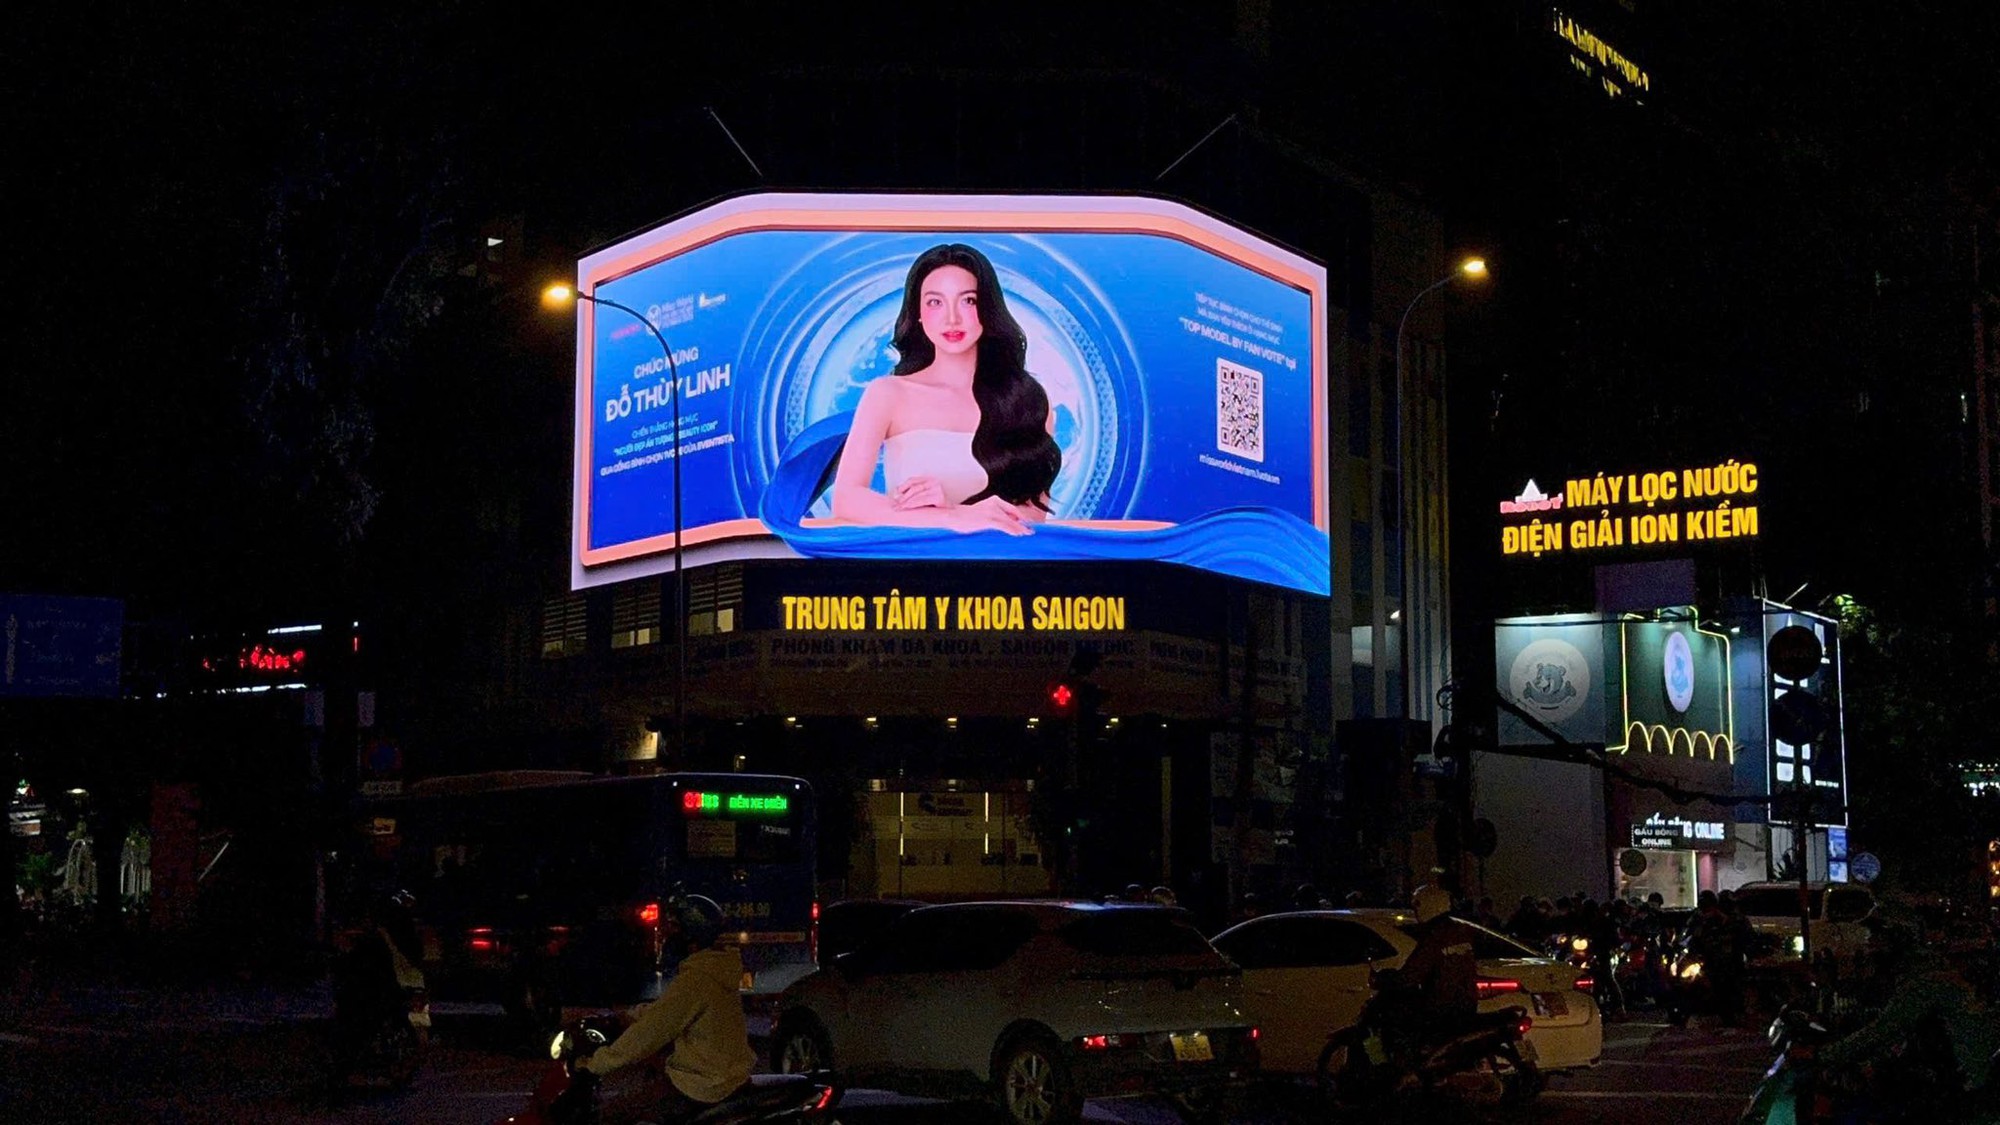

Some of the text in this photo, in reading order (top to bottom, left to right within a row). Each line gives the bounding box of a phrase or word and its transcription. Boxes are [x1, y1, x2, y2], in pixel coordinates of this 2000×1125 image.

[1200, 324, 1231, 346] MODEL
[634, 356, 664, 379] CHÚC
[606, 383, 632, 422] ĐỖ
[685, 363, 731, 399] LINH
[1566, 459, 1758, 508] MÁY LỌC NƯỚC
[1502, 500, 1758, 557] ĐIỆN GIẢI ION KIỀM
[783, 588, 1125, 630] TRUNG TÂM Y KHOA SAIGON
[1695, 821, 1725, 840] ONLINE
